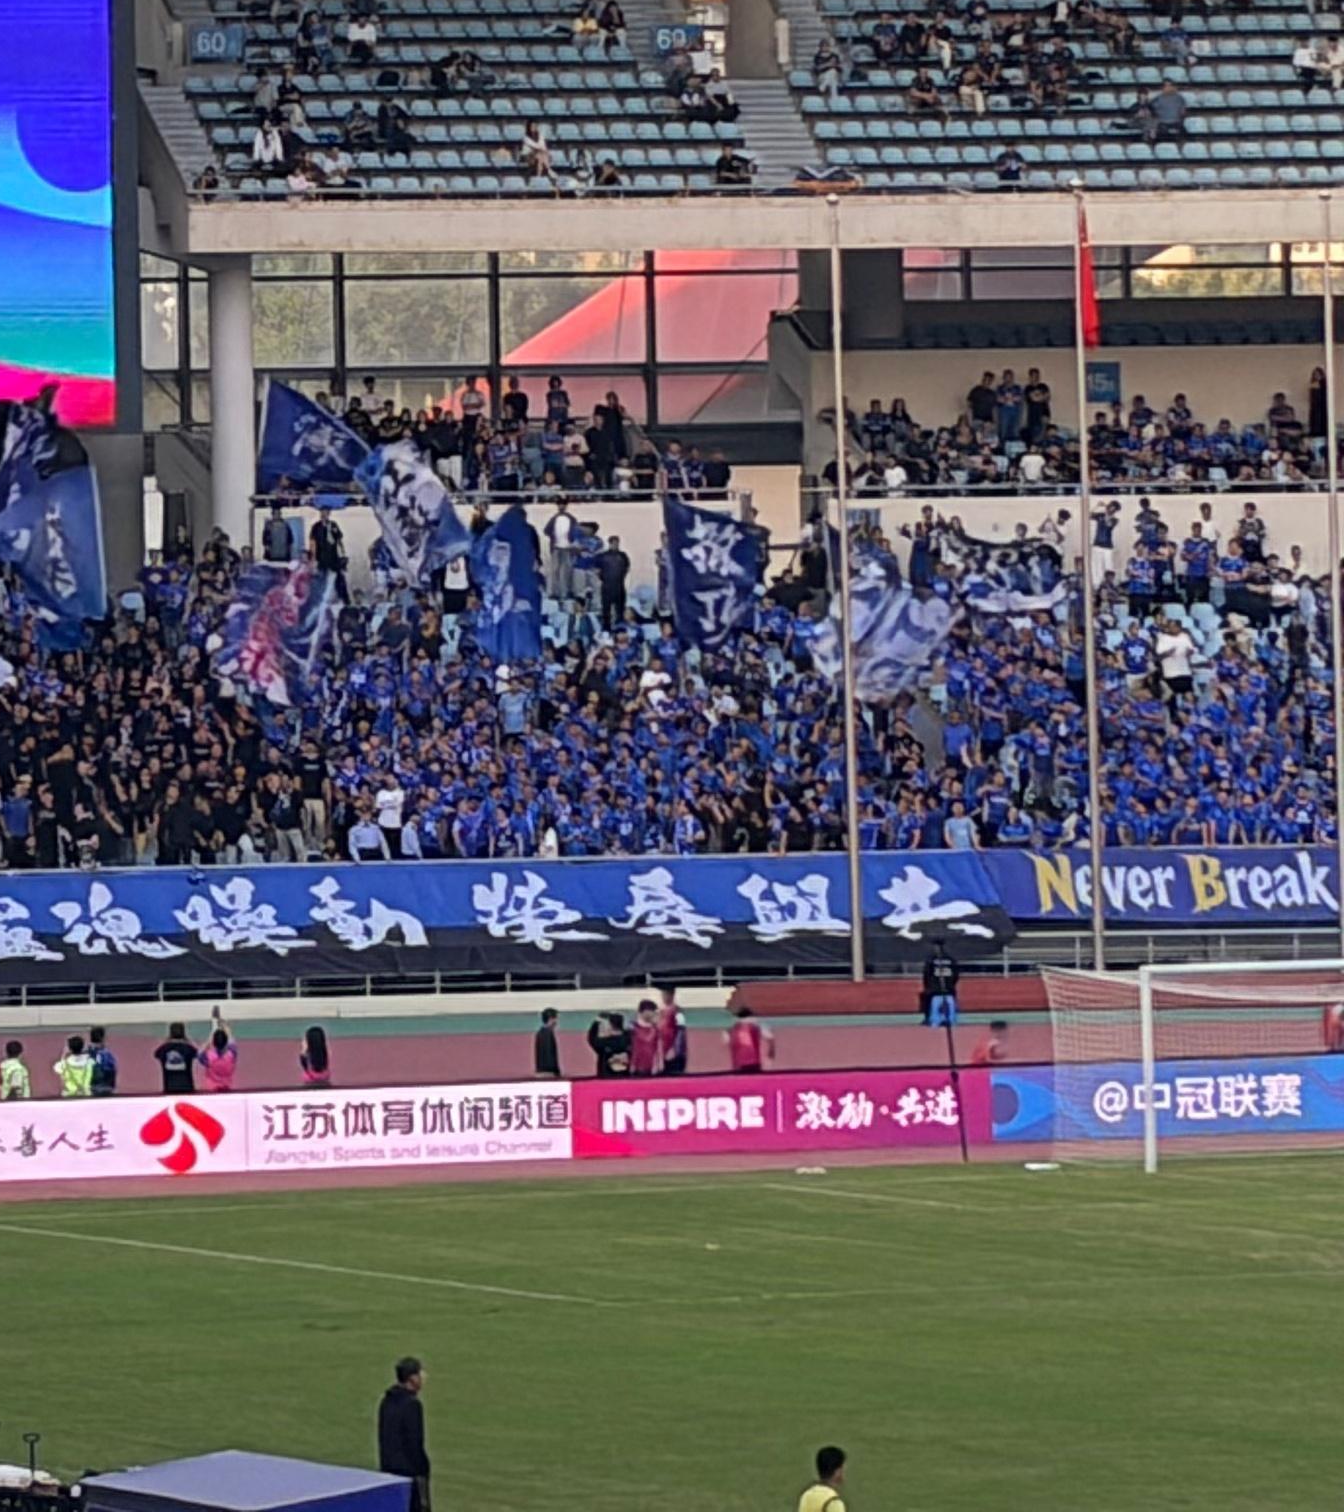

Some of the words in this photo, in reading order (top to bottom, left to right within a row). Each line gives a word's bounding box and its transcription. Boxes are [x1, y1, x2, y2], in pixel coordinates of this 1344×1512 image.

[197, 32, 226, 53] 60
[1021, 849, 1176, 914] Never
[1176, 850, 1340, 914] Break
[262, 1093, 571, 1142] 江苏体育休闲频道
[601, 1096, 765, 1134] INSPIRE
[1092, 1073, 1303, 1123] @中冠联赛
[332, 1145, 387, 1161] Sports
[390, 1146, 421, 1159] and
